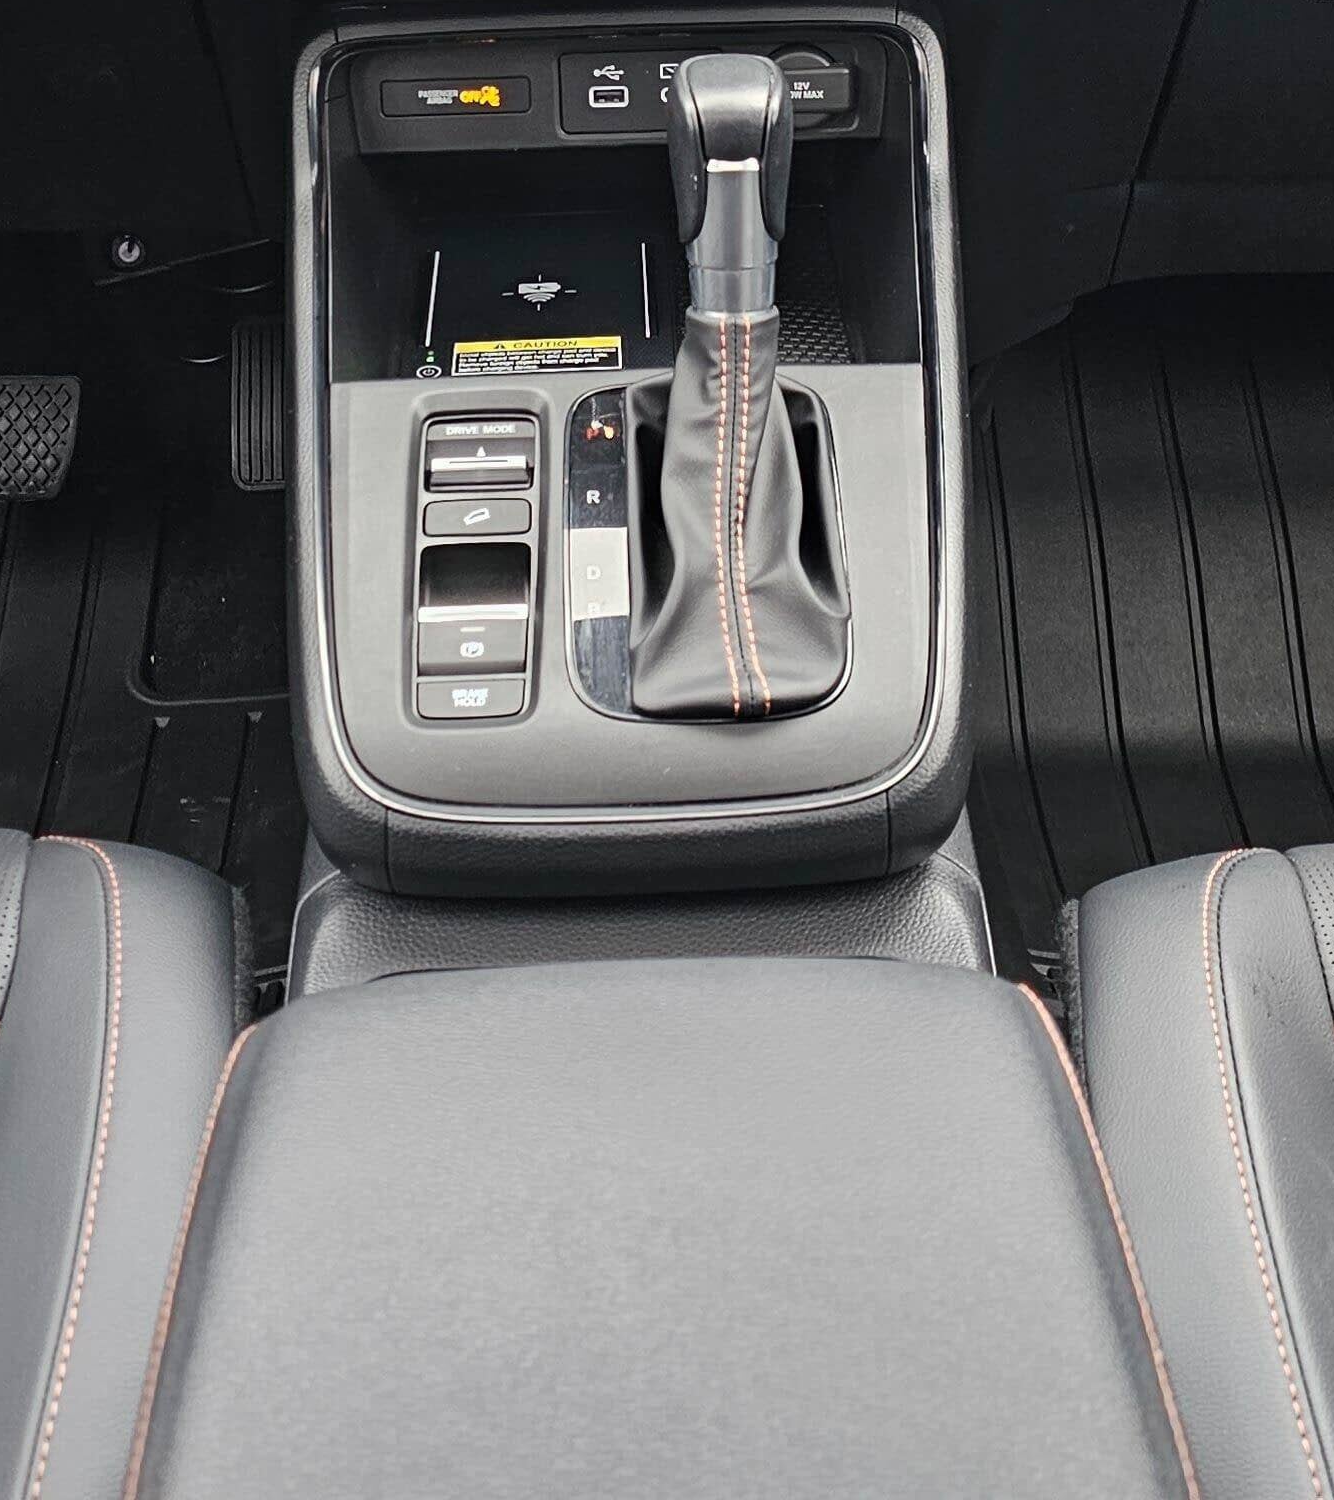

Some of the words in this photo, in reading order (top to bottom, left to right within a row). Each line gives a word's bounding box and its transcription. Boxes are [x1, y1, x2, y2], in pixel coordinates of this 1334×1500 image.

[793, 81, 810, 91] 12V
[802, 90, 824, 99] MAX
[513, 340, 578, 349] CAUTION
[445, 425, 479, 436] DRIVE
[483, 424, 516, 435] MODE
[586, 490, 600, 504] R
[586, 566, 601, 580] D
[454, 698, 487, 708] HOLD
